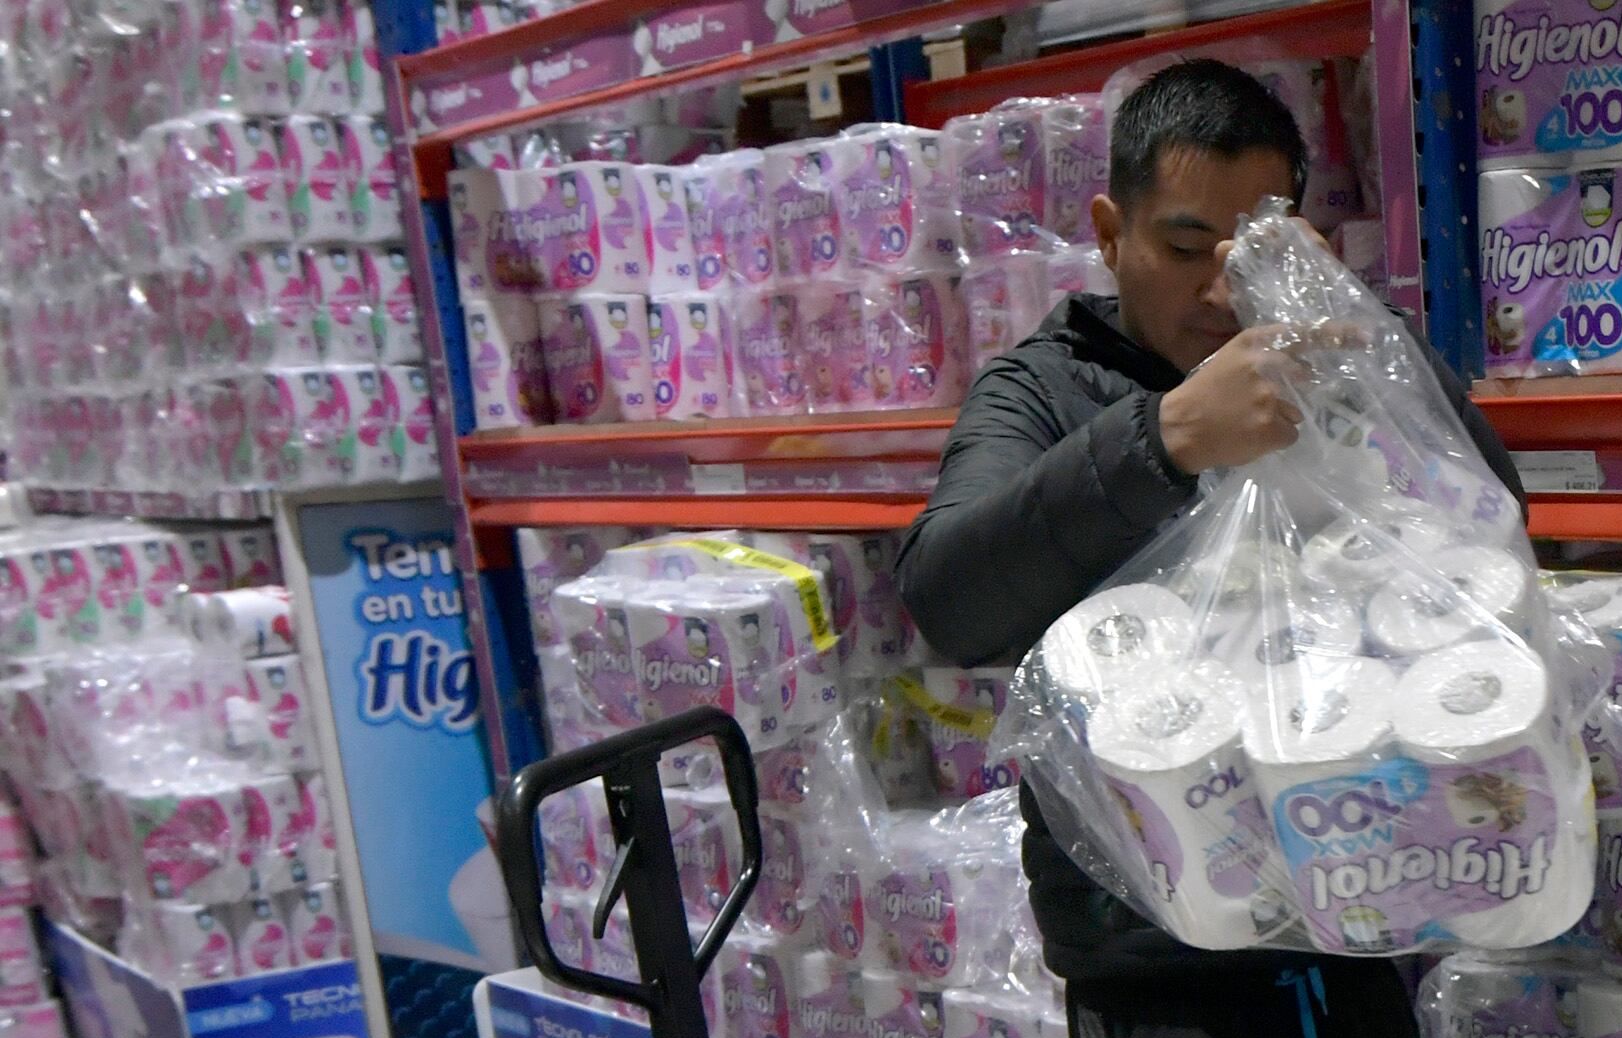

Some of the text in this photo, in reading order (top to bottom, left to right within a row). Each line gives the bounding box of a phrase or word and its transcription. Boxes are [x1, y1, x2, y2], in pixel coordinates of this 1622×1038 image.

[1566, 66, 1620, 89] MAX
[1568, 281, 1614, 301] MAX
[352, 535, 454, 582] Ten
[362, 594, 414, 622] en
[1183, 765, 1245, 810] 100
[1288, 781, 1402, 838] 100
[1316, 824, 1393, 858] MAX
[1311, 835, 1552, 911] Higienol
